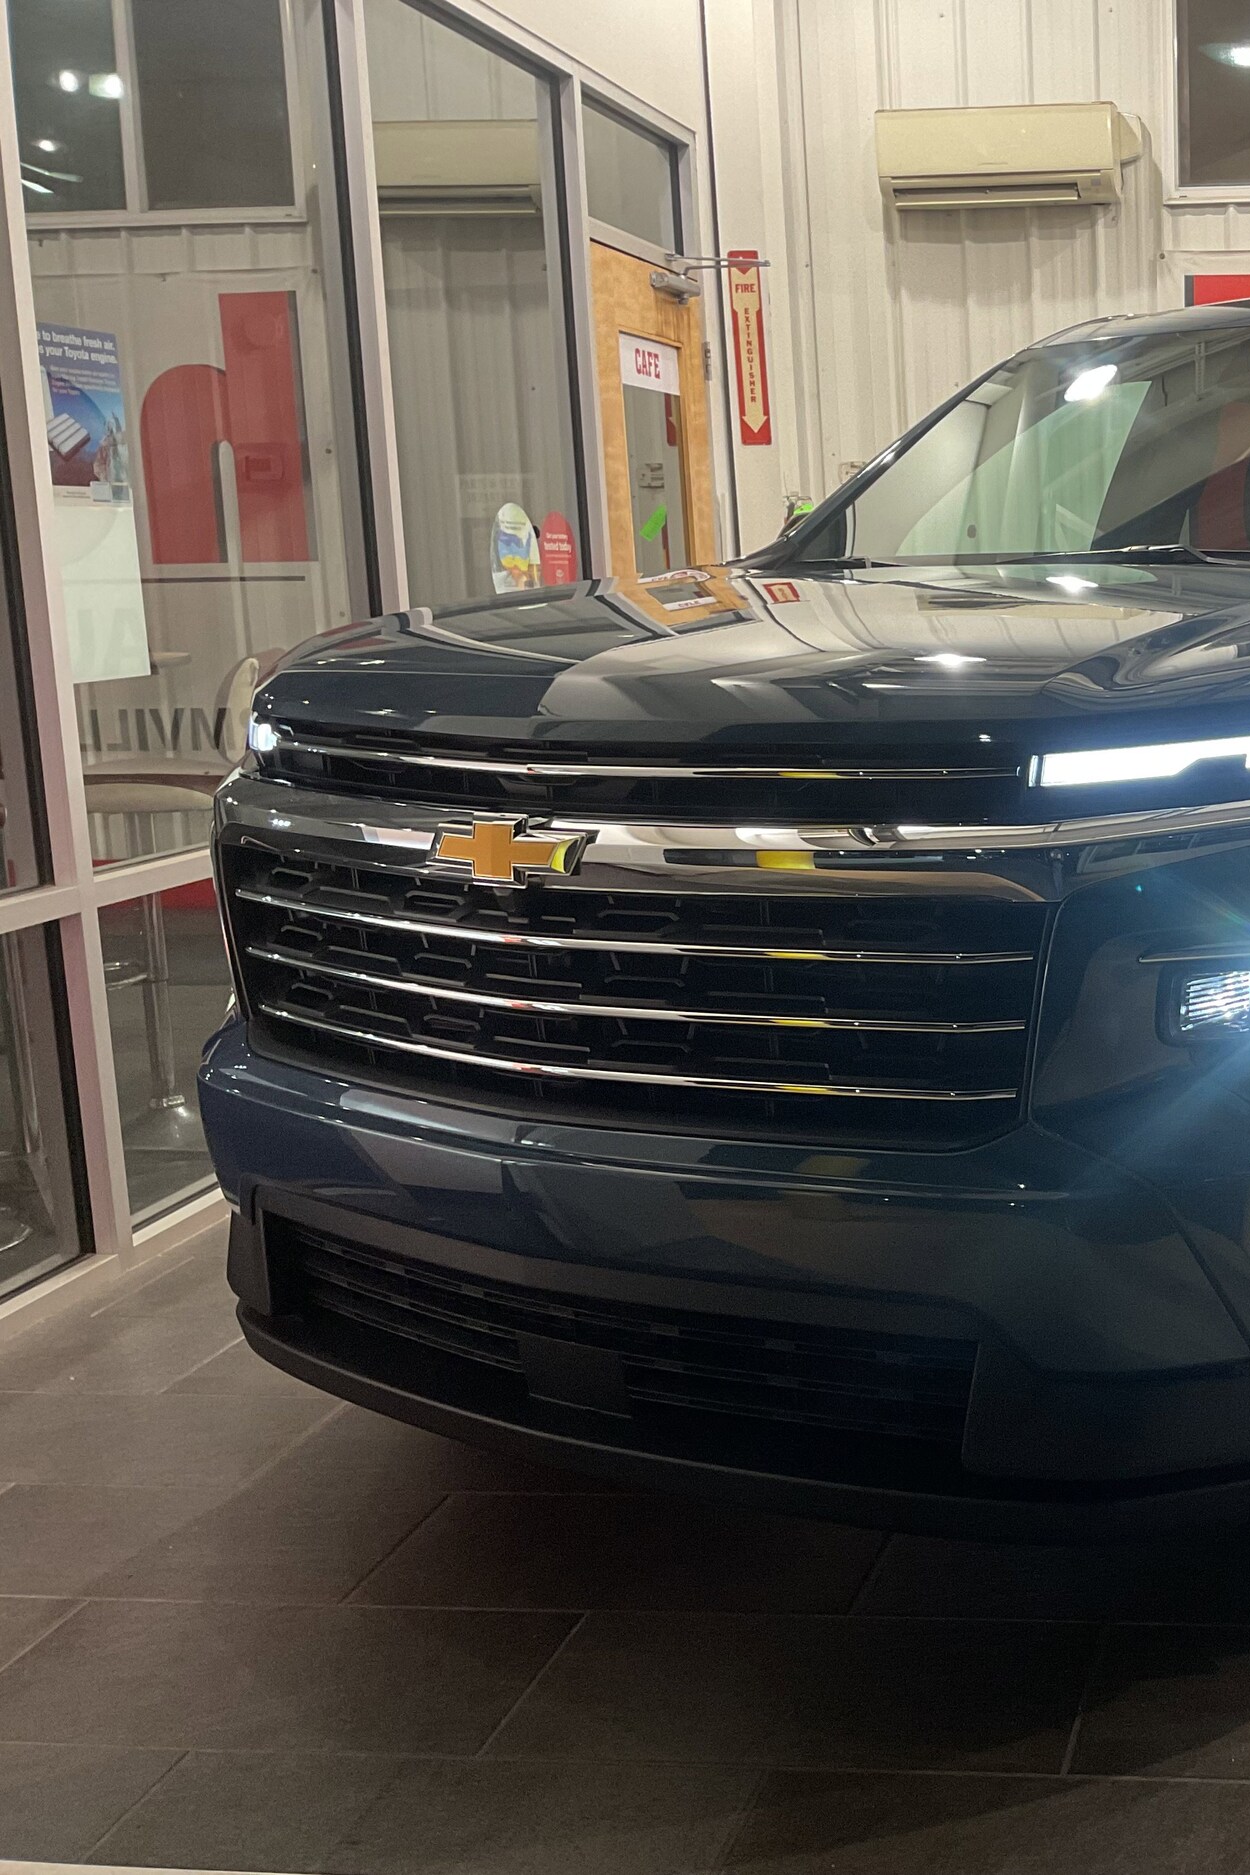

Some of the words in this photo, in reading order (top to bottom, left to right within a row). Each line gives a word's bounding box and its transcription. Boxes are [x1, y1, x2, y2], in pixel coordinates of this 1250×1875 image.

[735, 283, 756, 294] FIRE
[42, 330, 51, 341] to
[52, 331, 82, 346] breathe
[83, 336, 102, 349] fresh
[103, 340, 115, 351] air.
[45, 346, 63, 357] your
[64, 346, 89, 361] Toyota
[90, 352, 118, 365] engine.
[634, 348, 661, 380] CAFE
[744, 307, 757, 403] EXTINGUISHER
